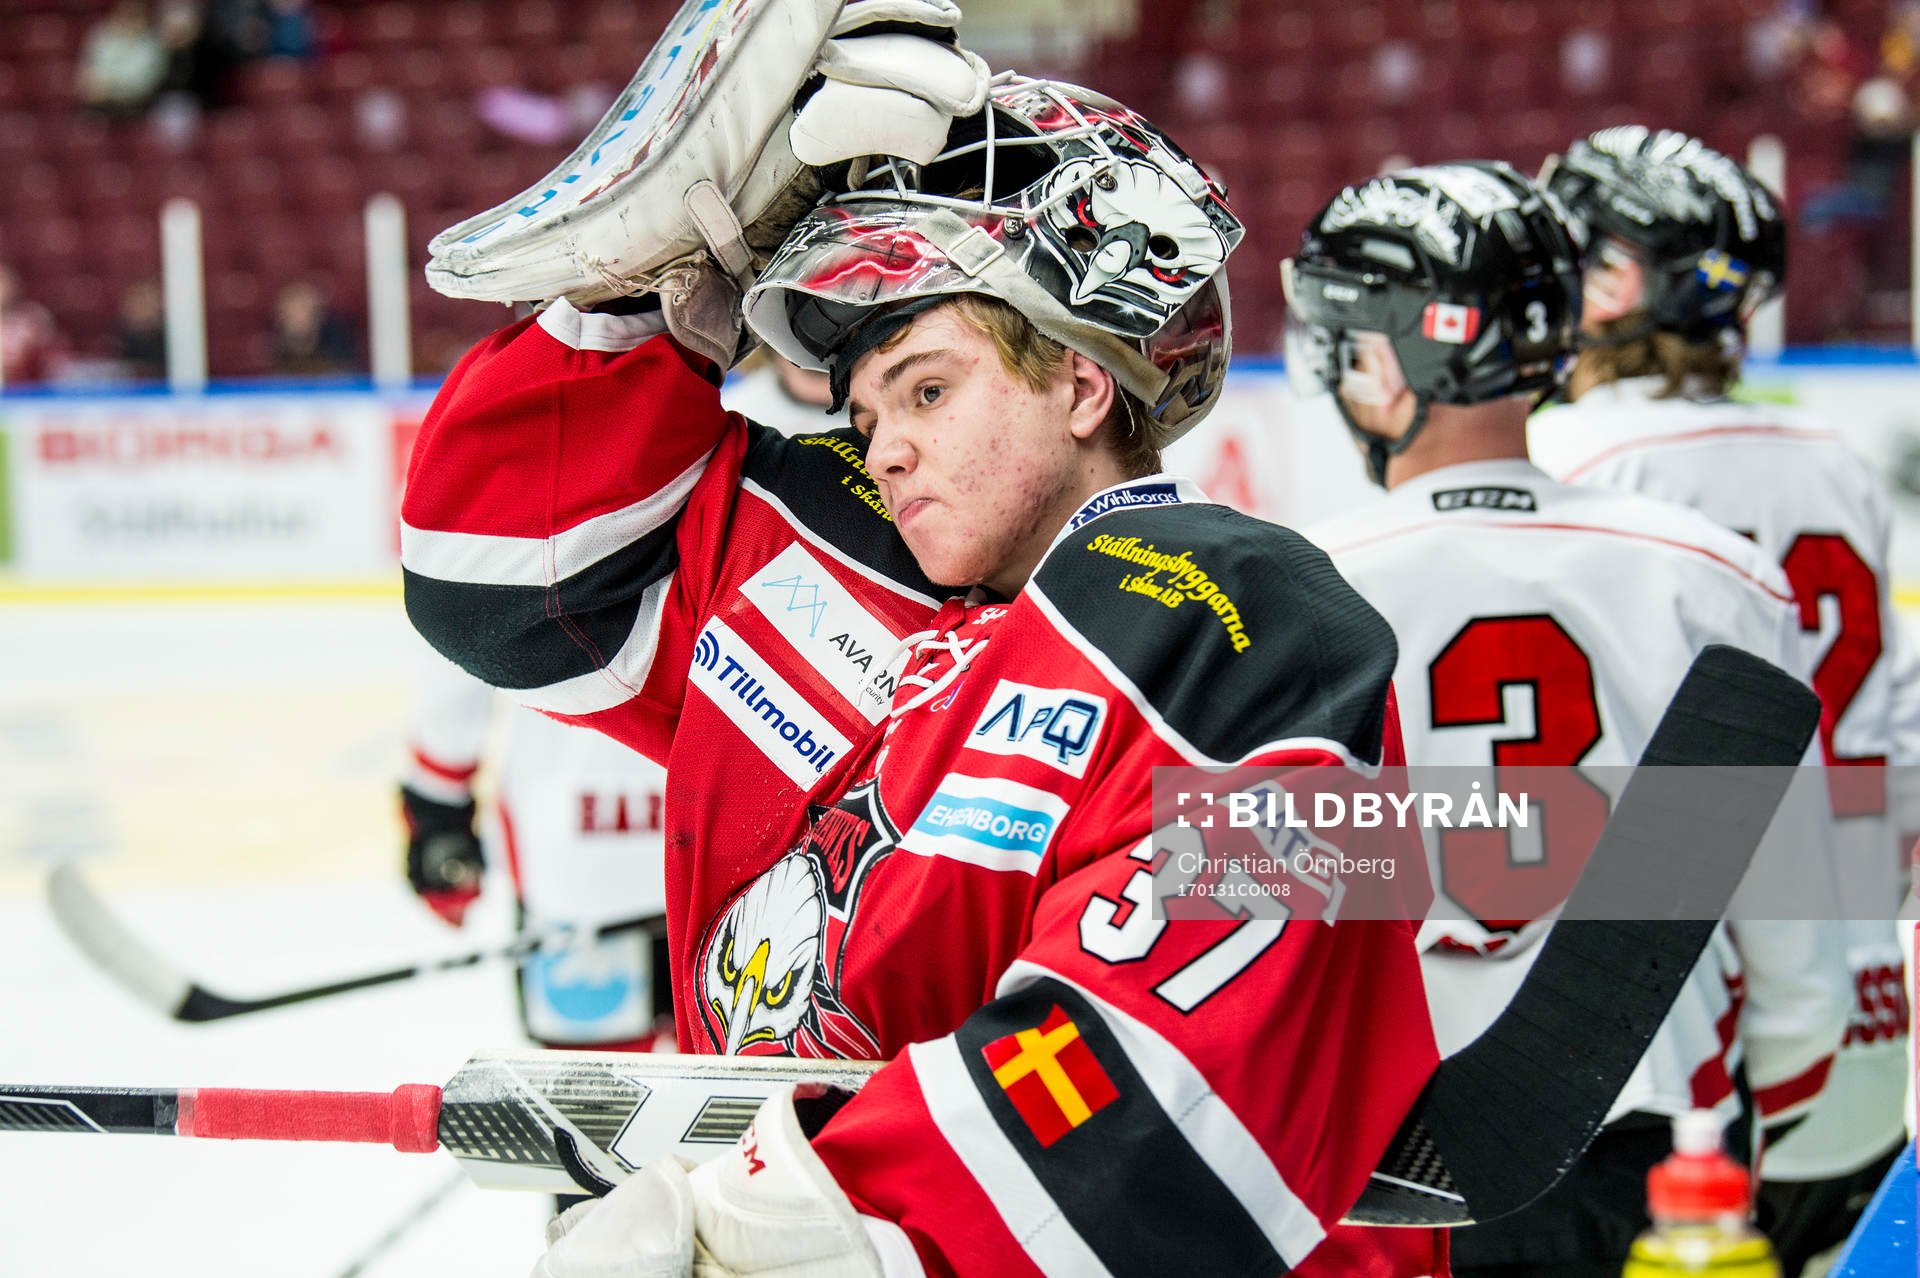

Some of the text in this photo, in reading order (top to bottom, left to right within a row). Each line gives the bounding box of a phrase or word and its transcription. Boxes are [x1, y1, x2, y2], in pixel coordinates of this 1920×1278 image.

[1525, 300, 1548, 344] 3
[850, 485, 894, 522] Skån
[1088, 488, 1180, 512] Wihlborgs
[1086, 533, 1252, 654] Ställningsbyggarna
[716, 655, 836, 774] Tillmobil
[1428, 614, 1611, 932] 3
[1078, 821, 1294, 1017] 37
